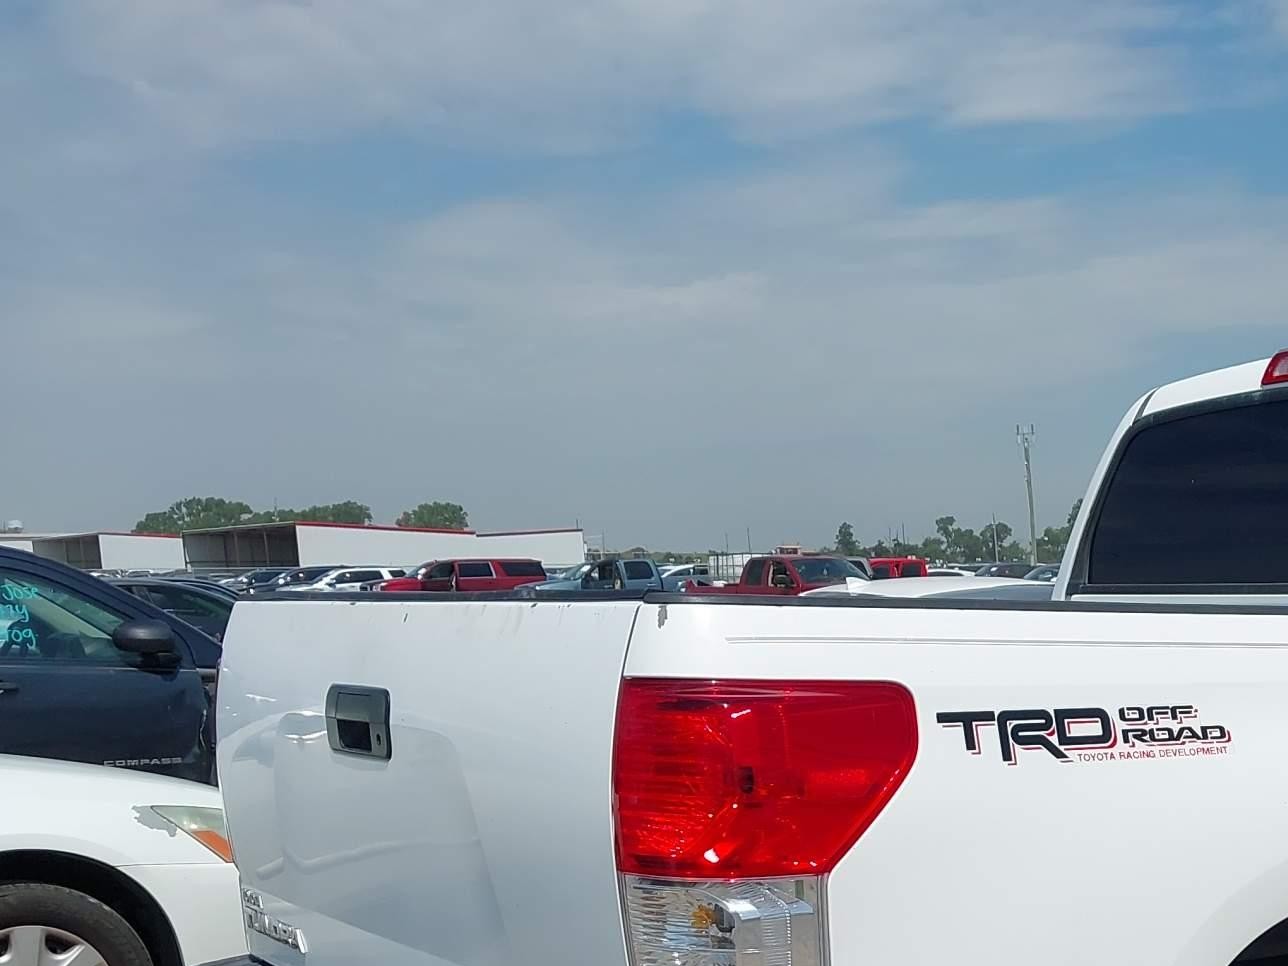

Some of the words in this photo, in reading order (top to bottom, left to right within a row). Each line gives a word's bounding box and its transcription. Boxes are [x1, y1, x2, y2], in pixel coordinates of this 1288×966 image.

[1118, 705, 1198, 724] OFF
[936, 705, 1117, 766] TRD
[1121, 725, 1232, 747] ROAD
[103, 757, 183, 767] COMPASS
[1078, 752, 1116, 762] TOYOTA
[1119, 749, 1156, 760] RACING
[1159, 746, 1229, 758] DEVELOPMENT
